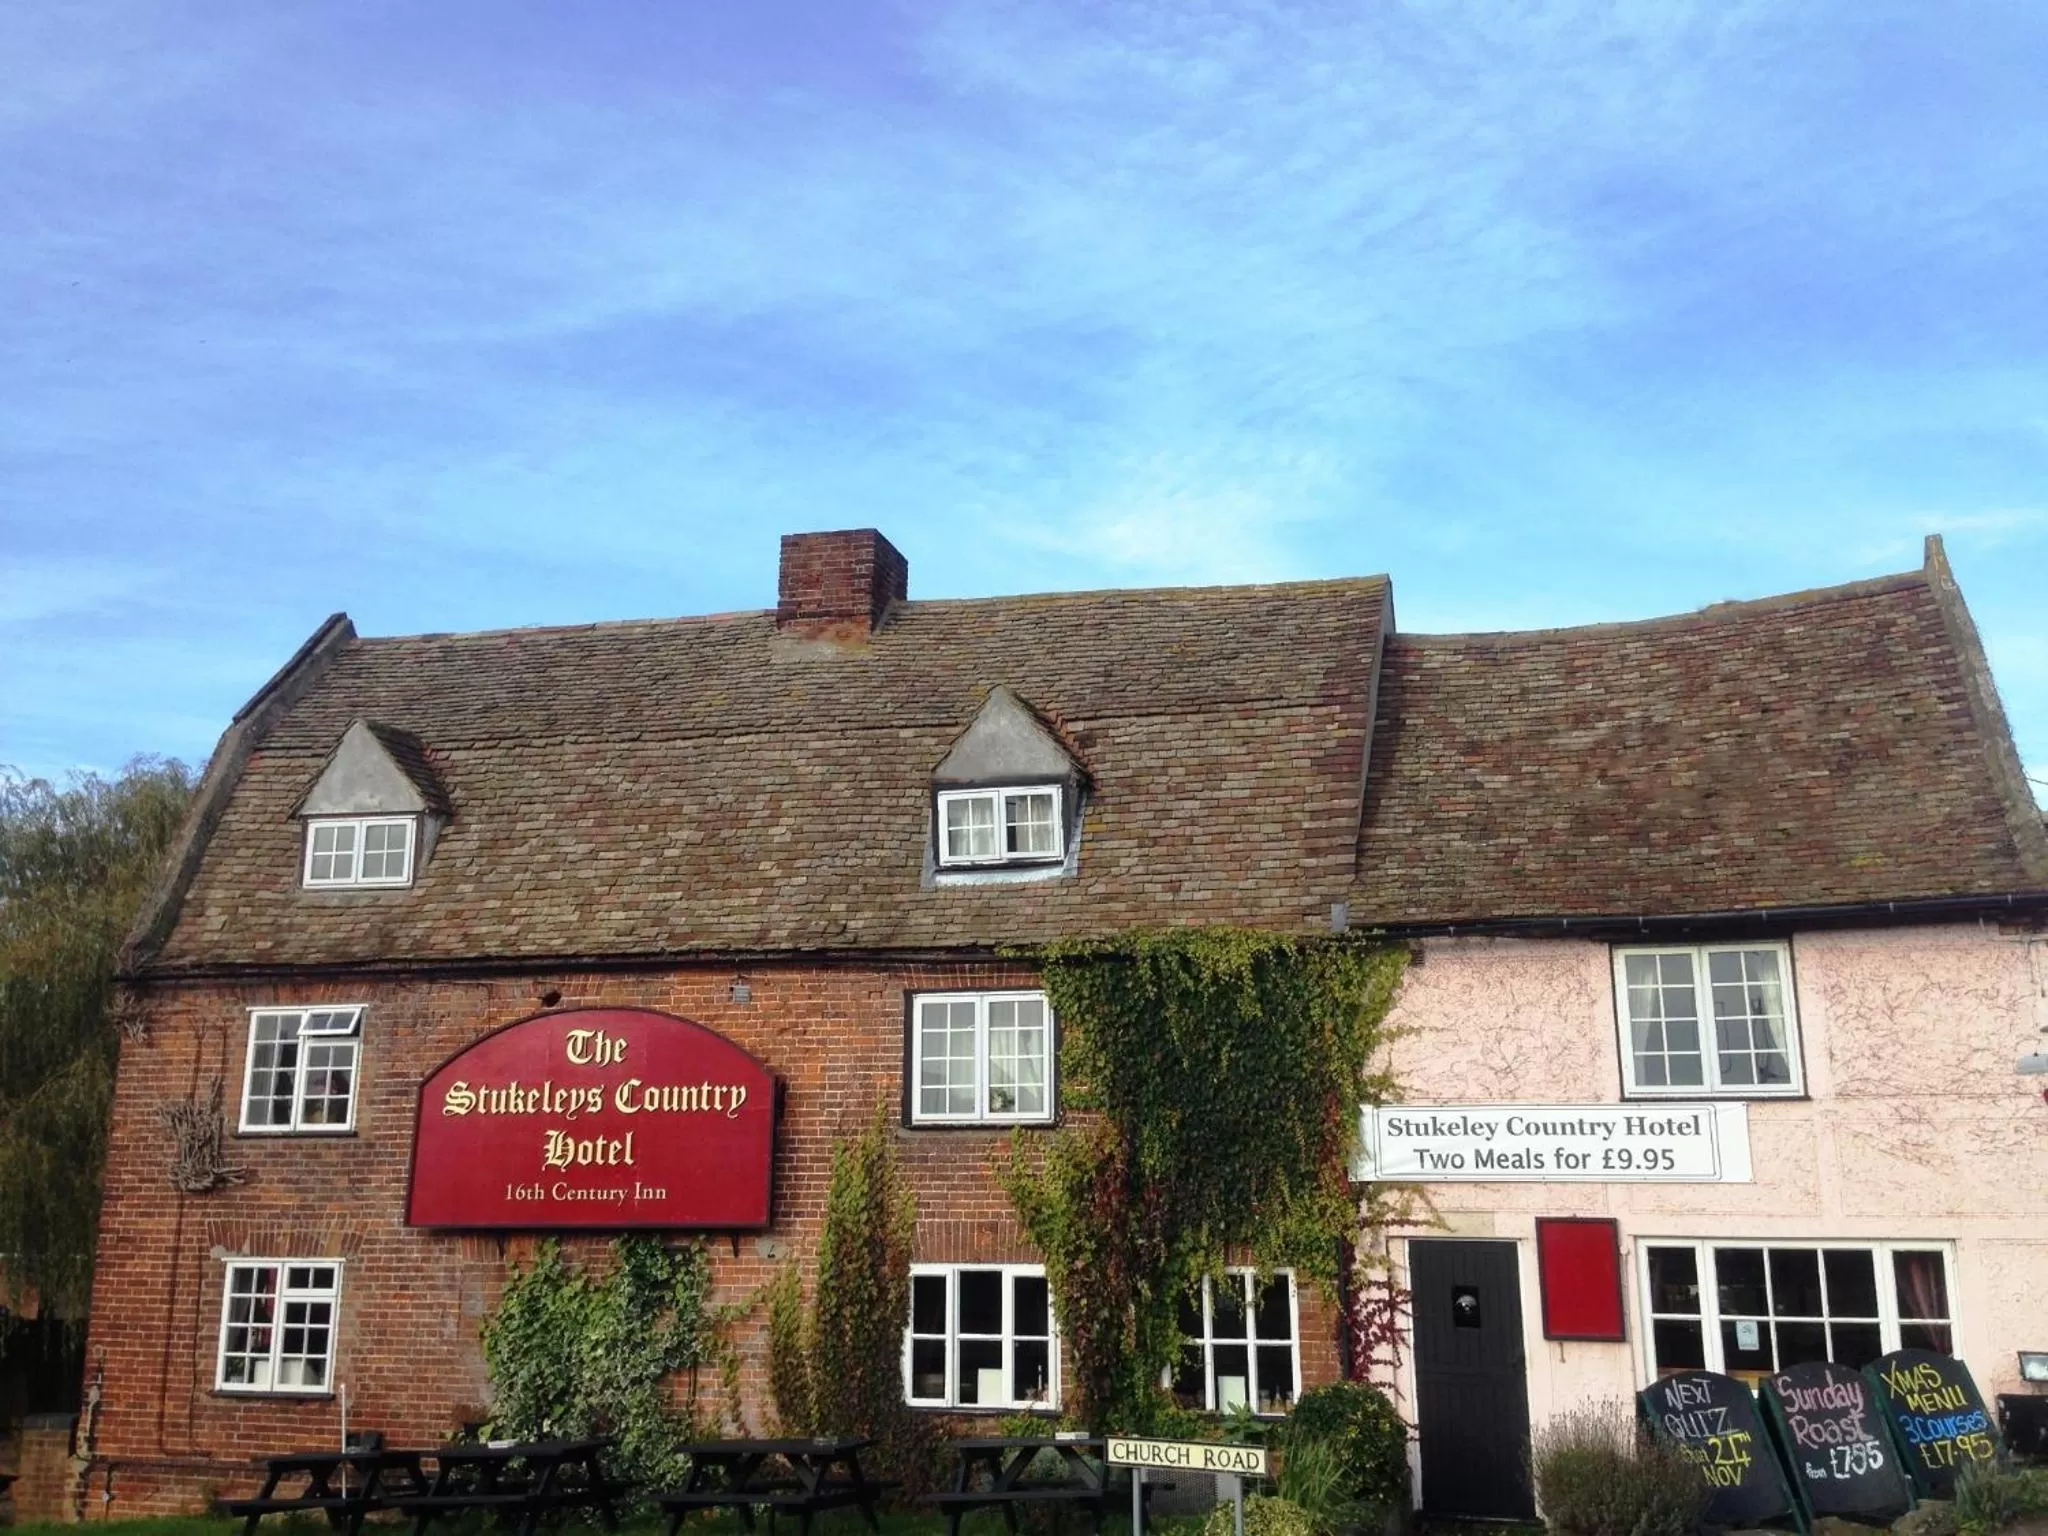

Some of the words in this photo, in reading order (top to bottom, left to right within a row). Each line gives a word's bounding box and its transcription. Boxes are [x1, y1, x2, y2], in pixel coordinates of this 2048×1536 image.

[566, 1029, 628, 1067] The
[443, 1081, 604, 1120] Stukeleys
[616, 1078, 747, 1119] Country
[1387, 1116, 1499, 1140] Stukeley
[1506, 1116, 1617, 1140] Country
[1625, 1114, 1702, 1137] Hotel
[542, 1130, 635, 1172] Hotel
[1413, 1149, 1465, 1170] Two
[1474, 1148, 1545, 1170] Meals
[1554, 1147, 1591, 1170] for
[1602, 1148, 1675, 1171] £9.95
[506, 1182, 545, 1201] 16th
[552, 1181, 628, 1207] Century
[634, 1181, 666, 1200] Inn
[1665, 1378, 1711, 1411] NEXT
[1778, 1369, 1864, 1413] Sunday
[1880, 1360, 1941, 1399] XMAS
[1906, 1385, 1968, 1415] MENU
[1665, 1406, 1740, 1440] QUIZ
[1788, 1408, 1874, 1450] Roast
[1113, 1442, 1190, 1464] CHURCH
[1204, 1449, 1260, 1469] ROAD
[1702, 1464, 1742, 1488] NOV
